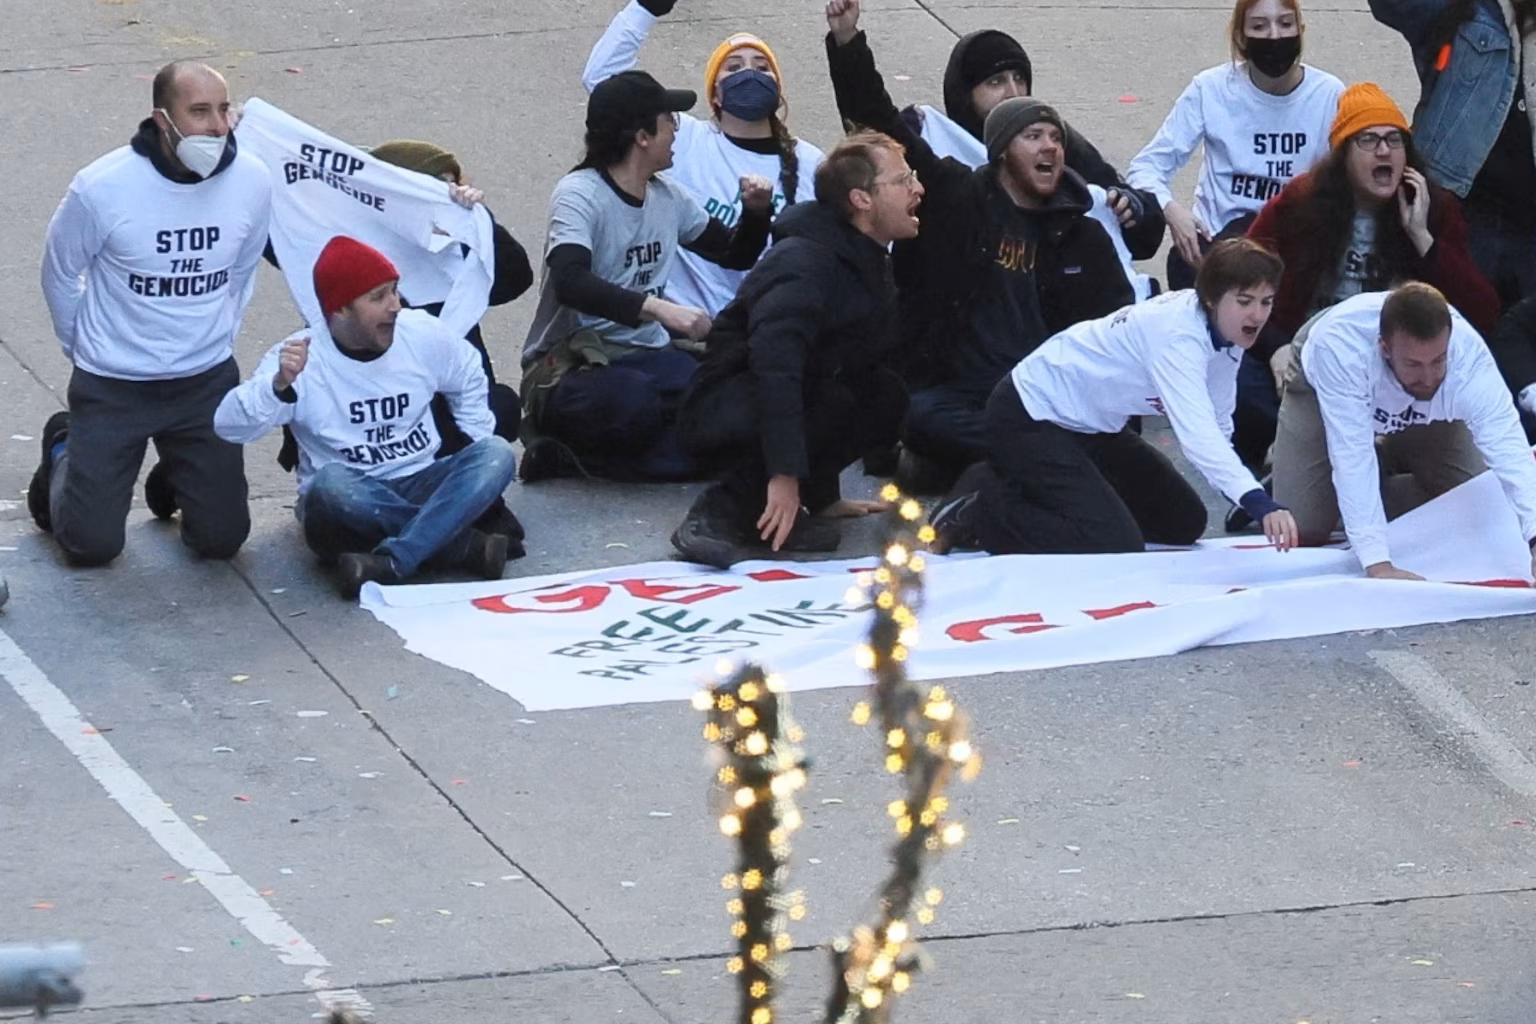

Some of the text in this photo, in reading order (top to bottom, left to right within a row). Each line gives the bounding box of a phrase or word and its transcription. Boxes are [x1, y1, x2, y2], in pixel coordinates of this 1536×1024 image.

[1254, 133, 1306, 154] STOP
[300, 143, 365, 176] STOP
[1265, 161, 1293, 177] THE
[156, 226, 220, 254] STOP
[170, 258, 204, 273] THE
[349, 393, 409, 424] STOP
[364, 425, 396, 443] THE
[549, 606, 711, 659] FREE
